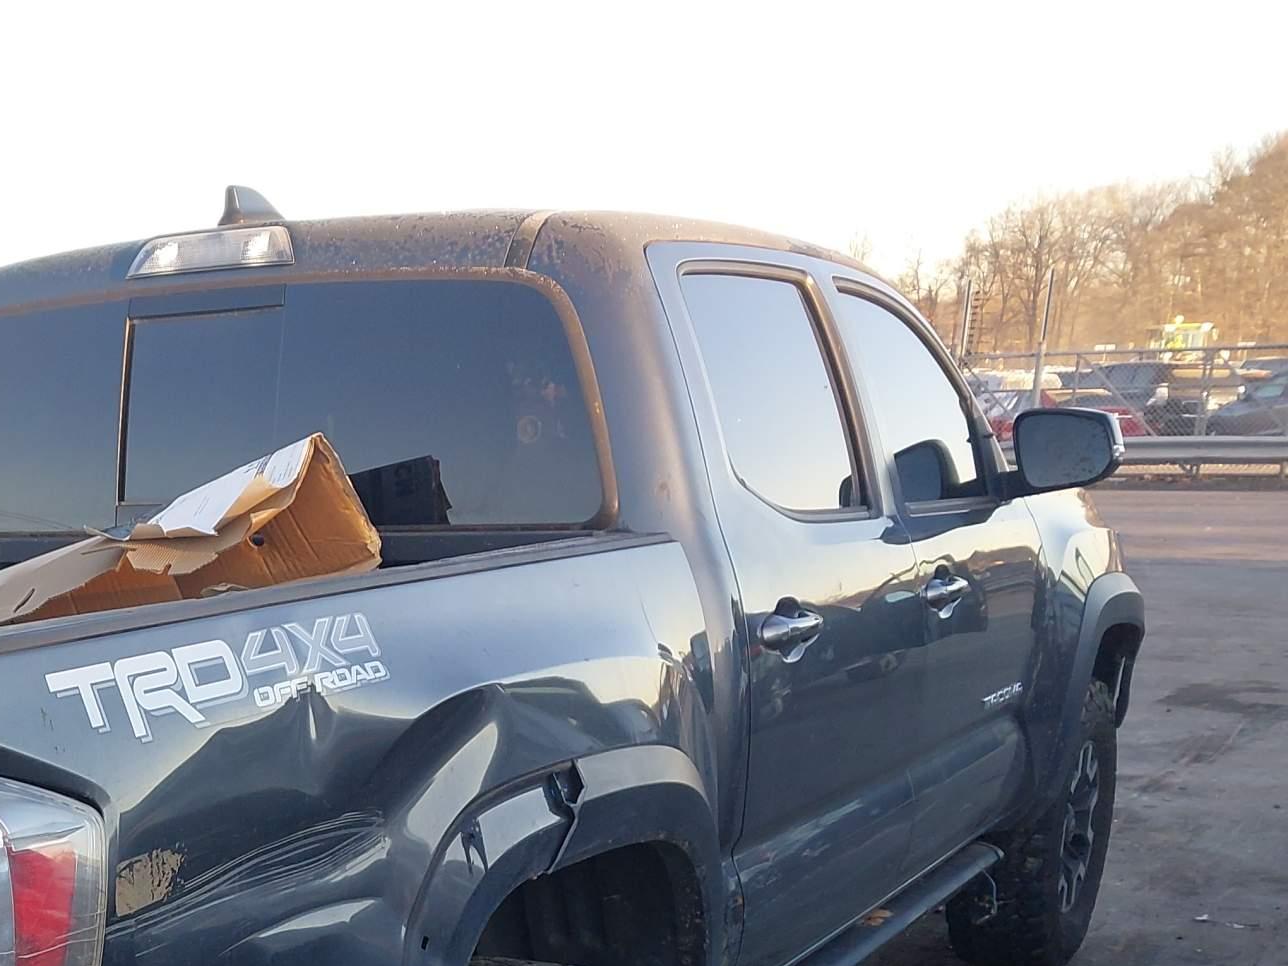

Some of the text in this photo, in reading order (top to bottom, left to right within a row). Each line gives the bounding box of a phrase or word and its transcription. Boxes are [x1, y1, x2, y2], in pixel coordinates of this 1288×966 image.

[44, 613, 382, 740] TRD 4X4
[253, 660, 387, 707] OFF ROAD
